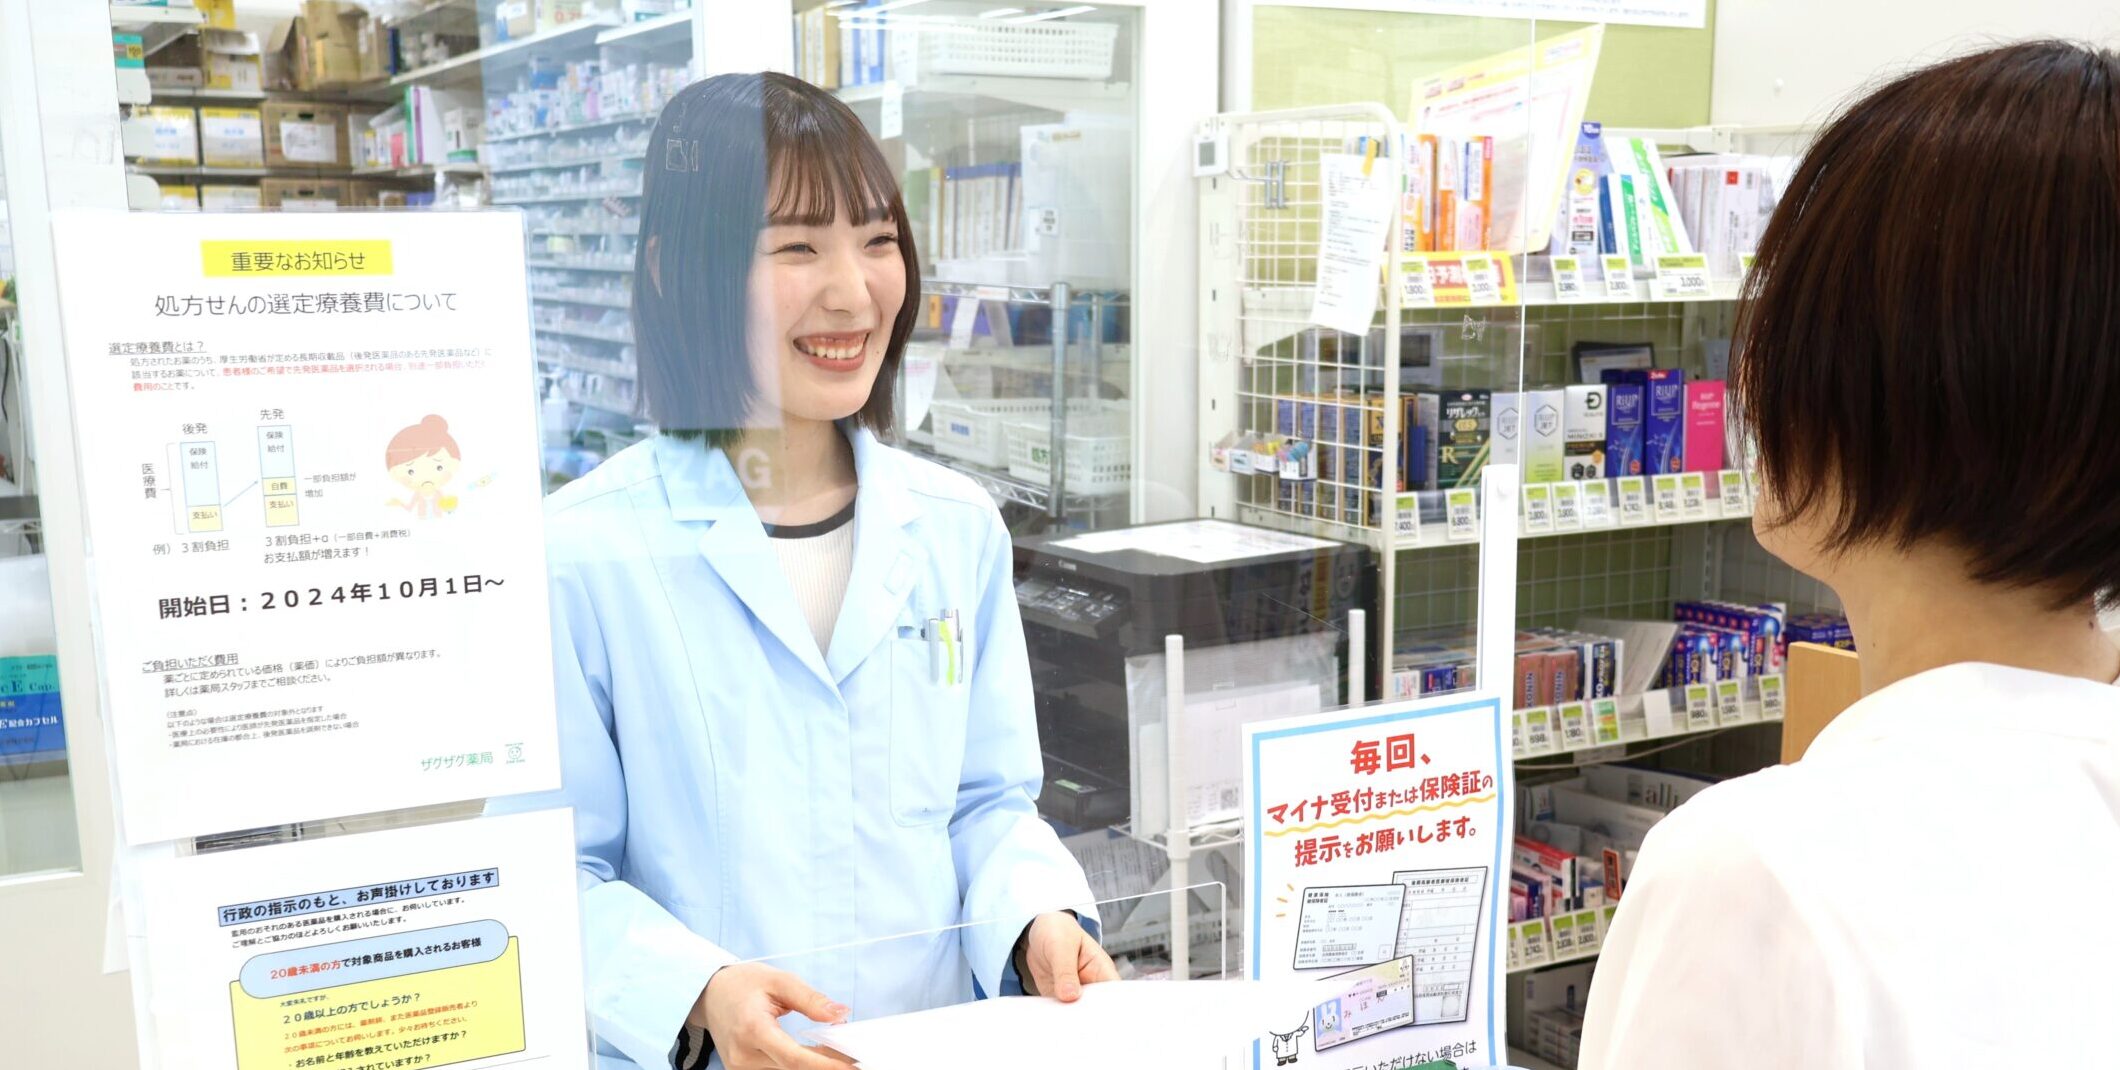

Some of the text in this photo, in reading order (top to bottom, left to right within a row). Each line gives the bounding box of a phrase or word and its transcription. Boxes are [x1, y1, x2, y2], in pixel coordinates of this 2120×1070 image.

[231, 251, 366, 272] 重要なお知らせ
[154, 291, 457, 318] 処方せんの選定療養費について
[133, 381, 196, 392] 費用のことです。
[260, 408, 285, 421] 先発
[182, 422, 208, 436] 後発
[142, 462, 158, 500] 医療費
[141, 652, 239, 674] ご負担いただく費用
[420, 750, 494, 772] ザグザグ薬局
[1350, 733, 1432, 776] 毎回、
[1267, 770, 1494, 825] マイナ受付または保険証の
[1295, 815, 1477, 868] 提示をお願いします。
[223, 870, 496, 923] 行政の指示のもと、お声掛けしております
